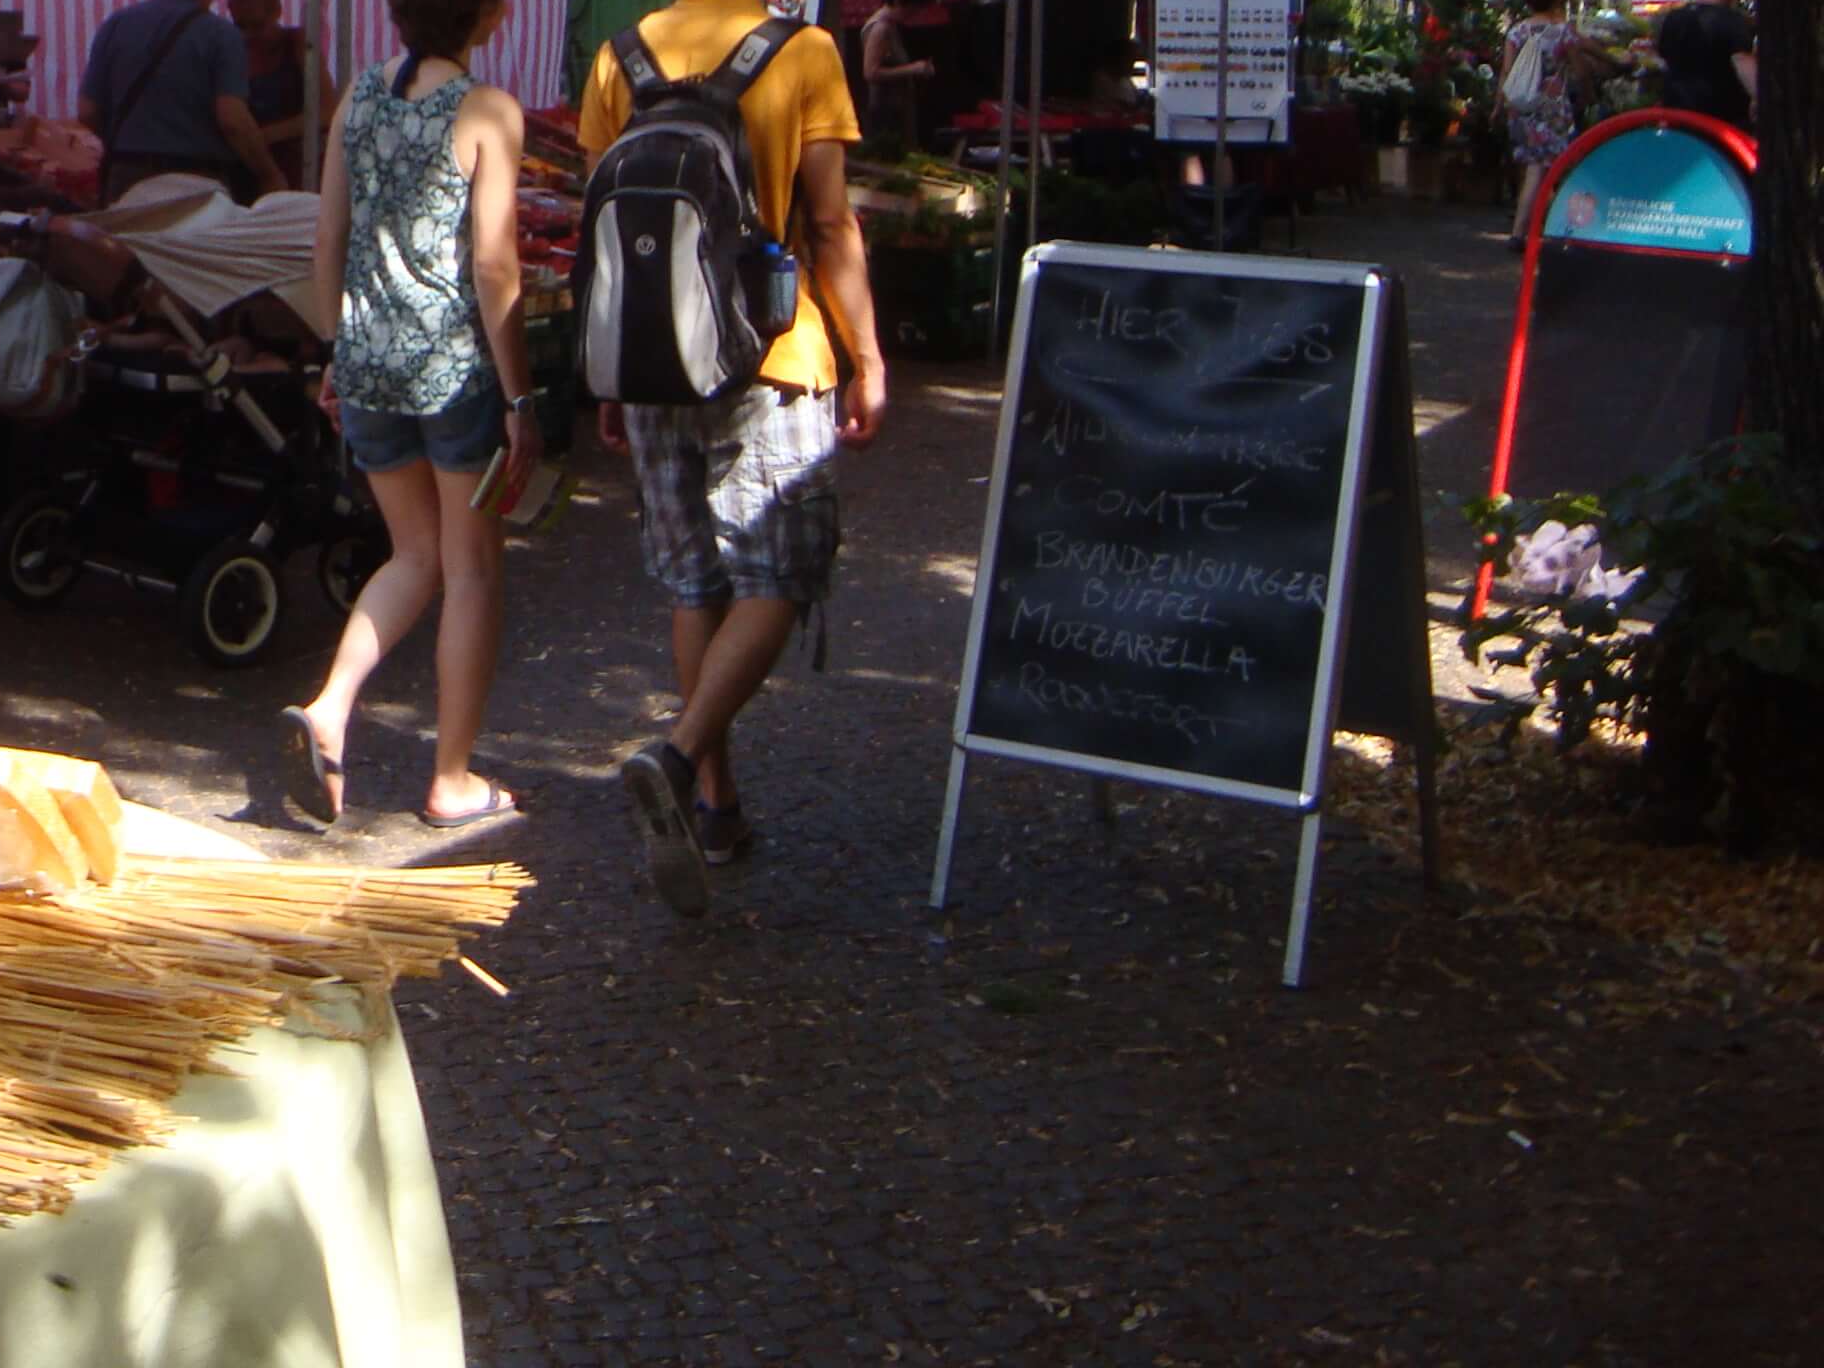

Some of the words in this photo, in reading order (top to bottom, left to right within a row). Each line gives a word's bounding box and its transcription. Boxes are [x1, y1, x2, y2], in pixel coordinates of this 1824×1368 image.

[1075, 289, 1188, 356] HIER
[1034, 529, 1328, 613] BRANDENBURGER
[1080, 575, 1230, 628] BÜFFEL
[1009, 595, 1257, 682] MOZZARELLA
